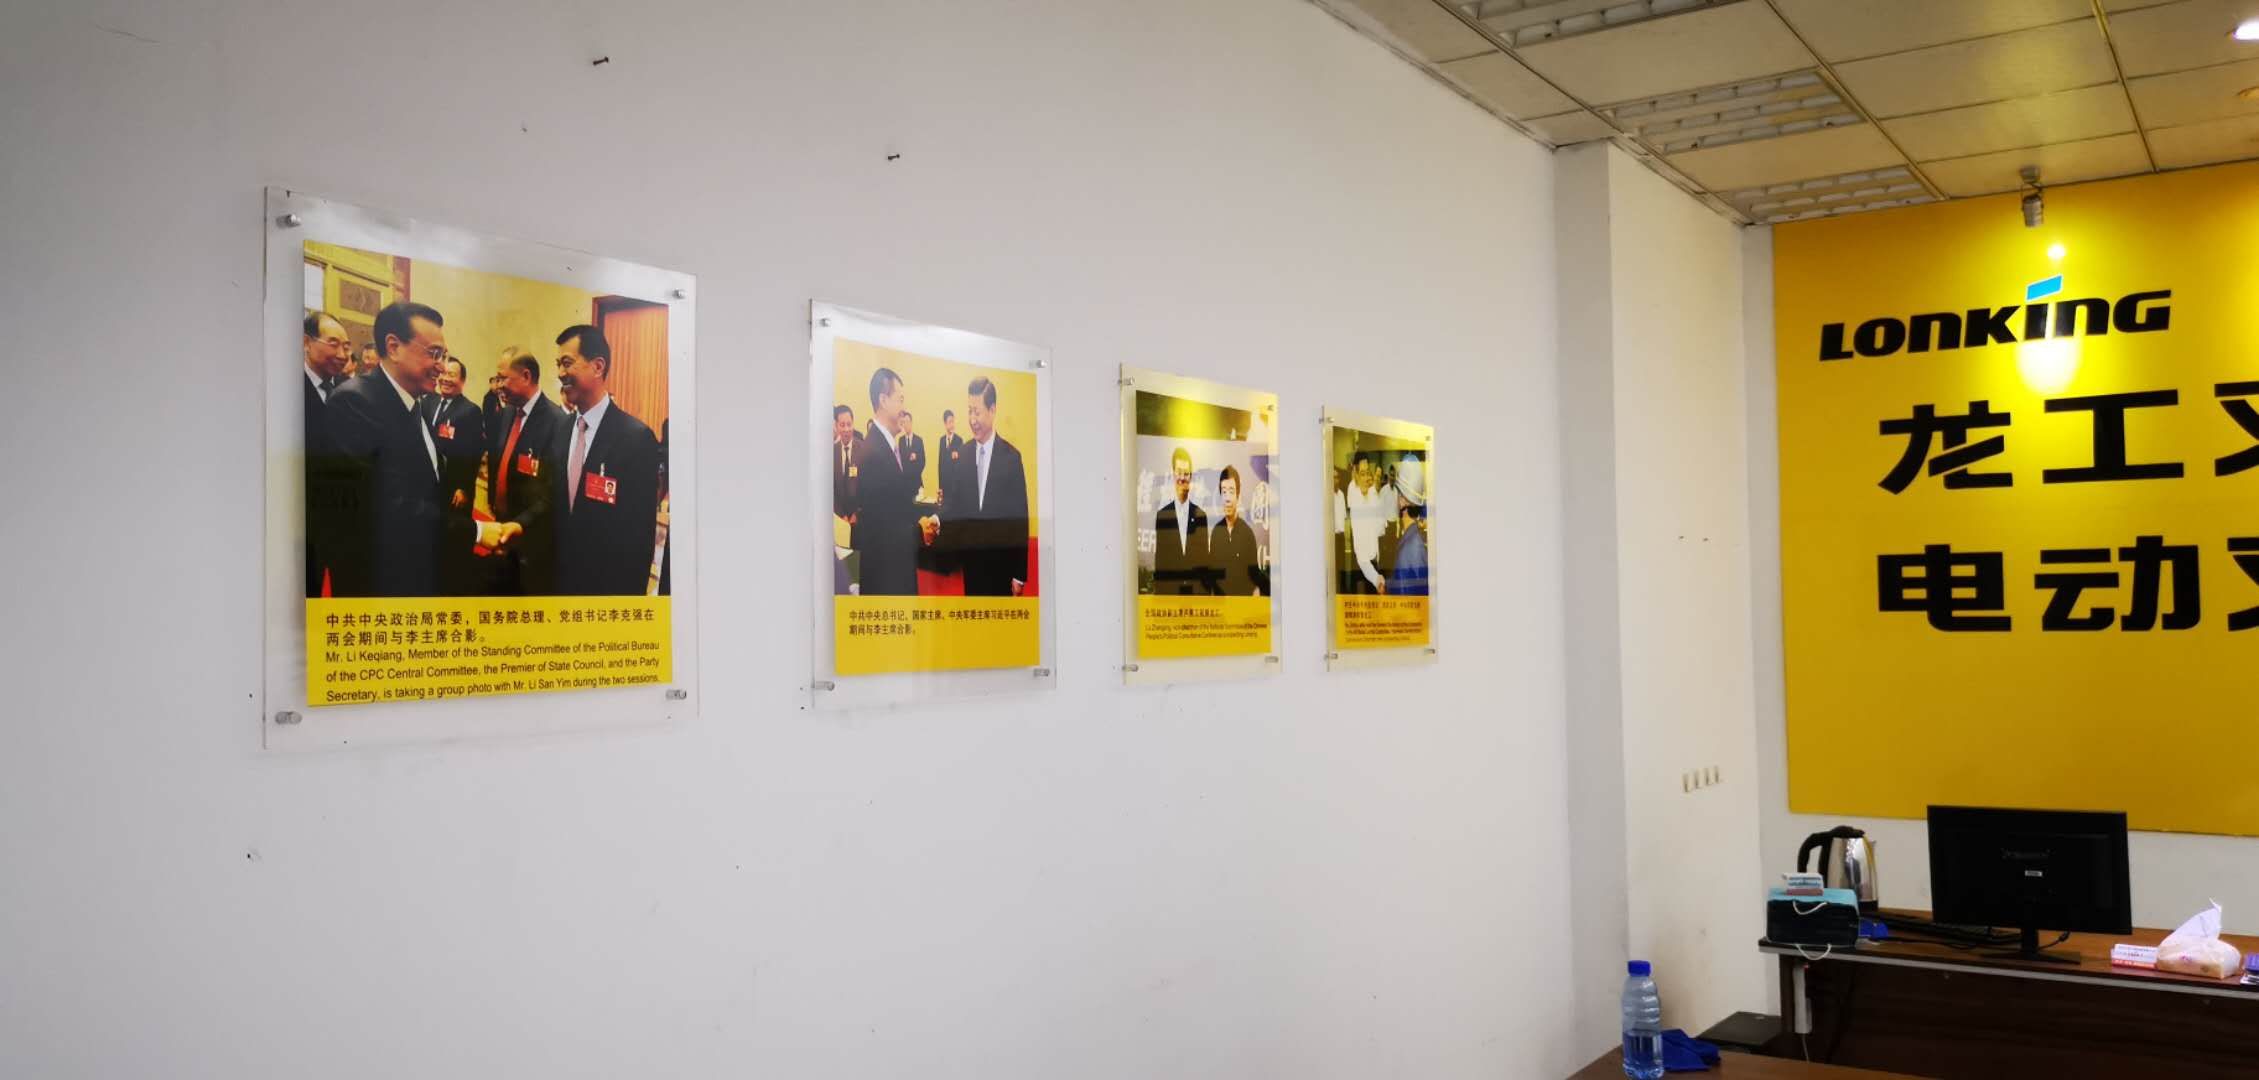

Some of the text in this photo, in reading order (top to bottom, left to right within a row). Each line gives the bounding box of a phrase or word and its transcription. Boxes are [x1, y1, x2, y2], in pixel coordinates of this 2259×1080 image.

[1819, 276, 2172, 362] LONKING
[1877, 534, 2259, 632] 电动
[326, 651, 342, 663] Mr.
[347, 651, 356, 662] Li
[408, 648, 448, 660] Member
[451, 647, 461, 658] of
[463, 646, 478, 657] the
[481, 644, 521, 658] Standing
[524, 643, 571, 656] Committee
[573, 642, 582, 653] of
[583, 642, 596, 653] the
[598, 641, 630, 652] Political
[631, 640, 660, 651] Bureau
[326, 670, 337, 683] of
[339, 670, 356, 681] the
[359, 669, 385, 681] CPC
[387, 667, 424, 679] Central
[483, 664, 498, 675] the
[501, 662, 535, 674] Premier
[539, 661, 548, 672] of
[549, 660, 571, 671] State
[608, 657, 624, 669] and
[625, 657, 638, 668] the
[639, 656, 660, 669] Party
[383, 688, 393, 699] is
[395, 686, 425, 699] taking
[428, 688, 434, 696] a
[437, 685, 464, 699] group
[467, 683, 493, 697] photo
[494, 681, 511, 693] with
[538, 678, 555, 690] San
[573, 675, 597, 688] during
[599, 675, 611, 685] the
